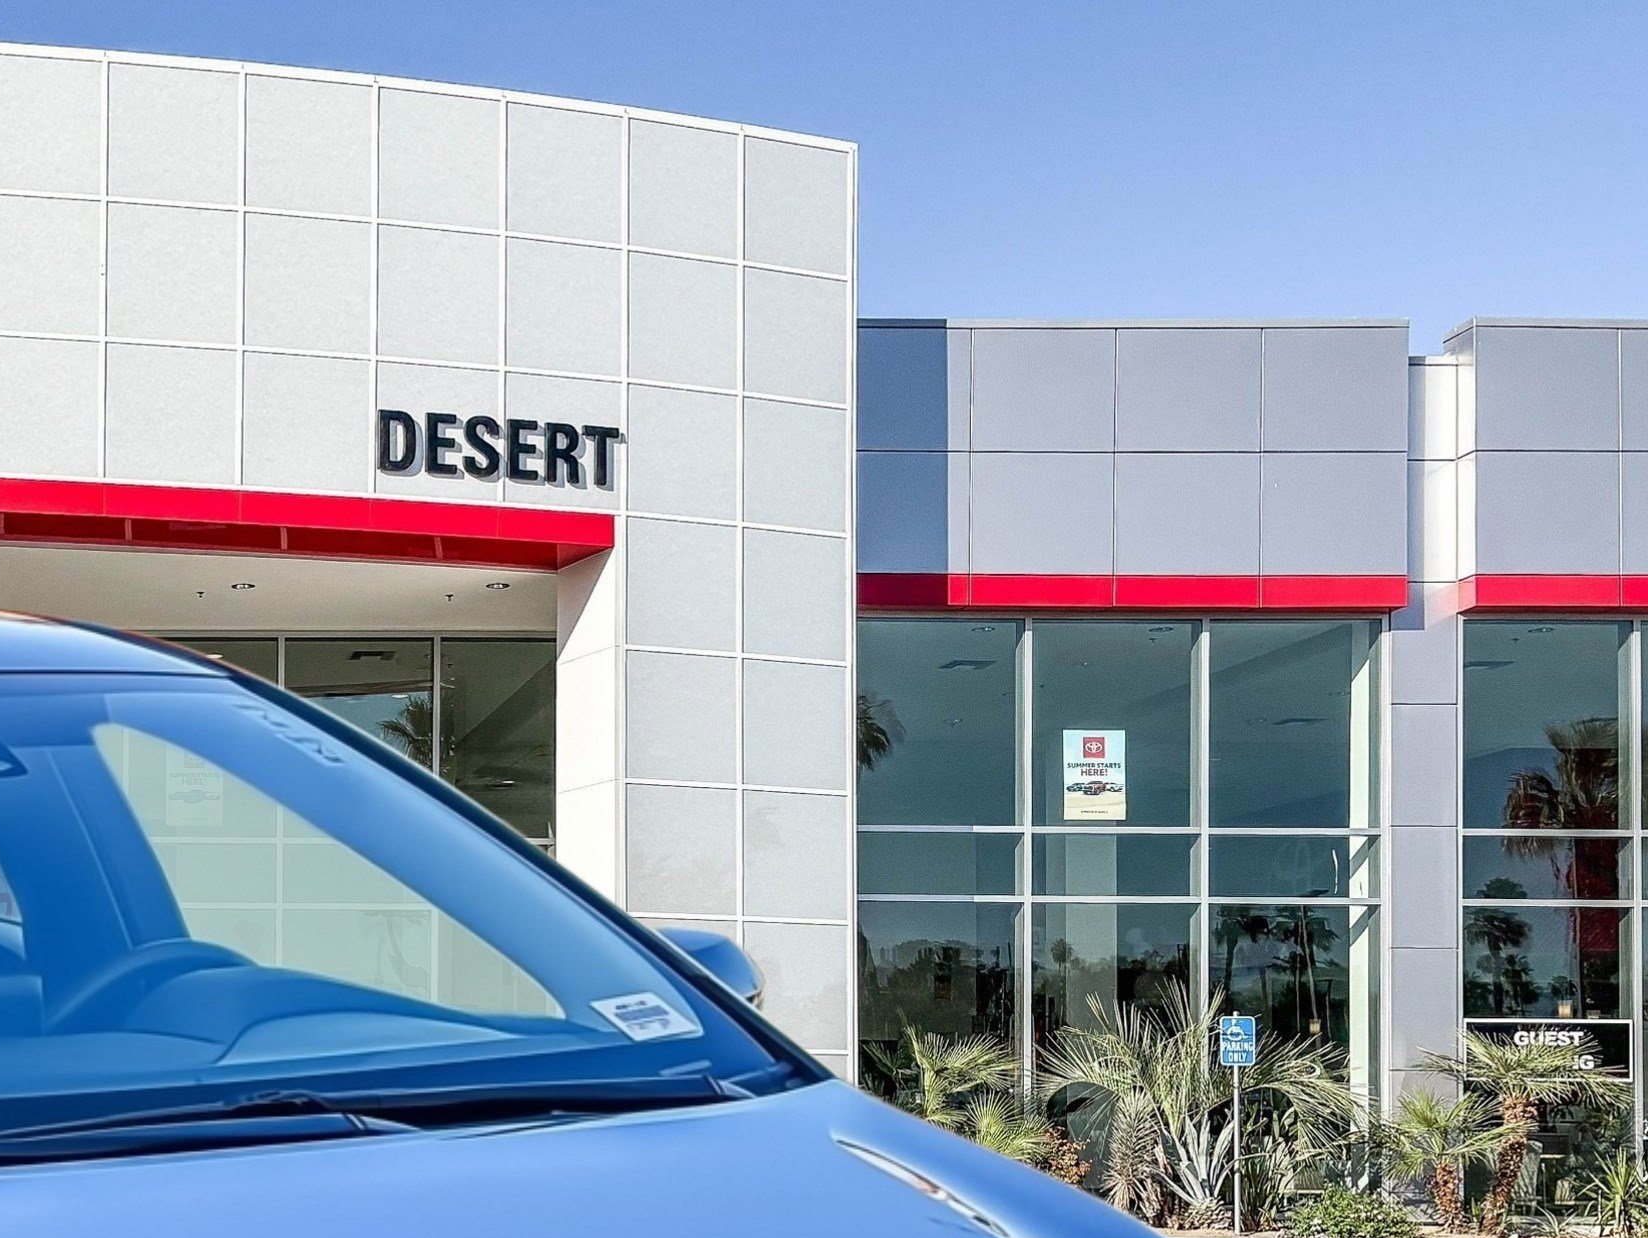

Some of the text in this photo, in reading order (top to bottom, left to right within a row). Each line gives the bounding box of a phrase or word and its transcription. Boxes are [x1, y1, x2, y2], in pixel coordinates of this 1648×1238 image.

[377, 408, 620, 487] DESERT
[1081, 768, 1108, 777] HERE!
[1513, 1031, 1584, 1046] GUEST
[1222, 1041, 1254, 1052] PARKING
[1228, 1052, 1248, 1063] ONLY
